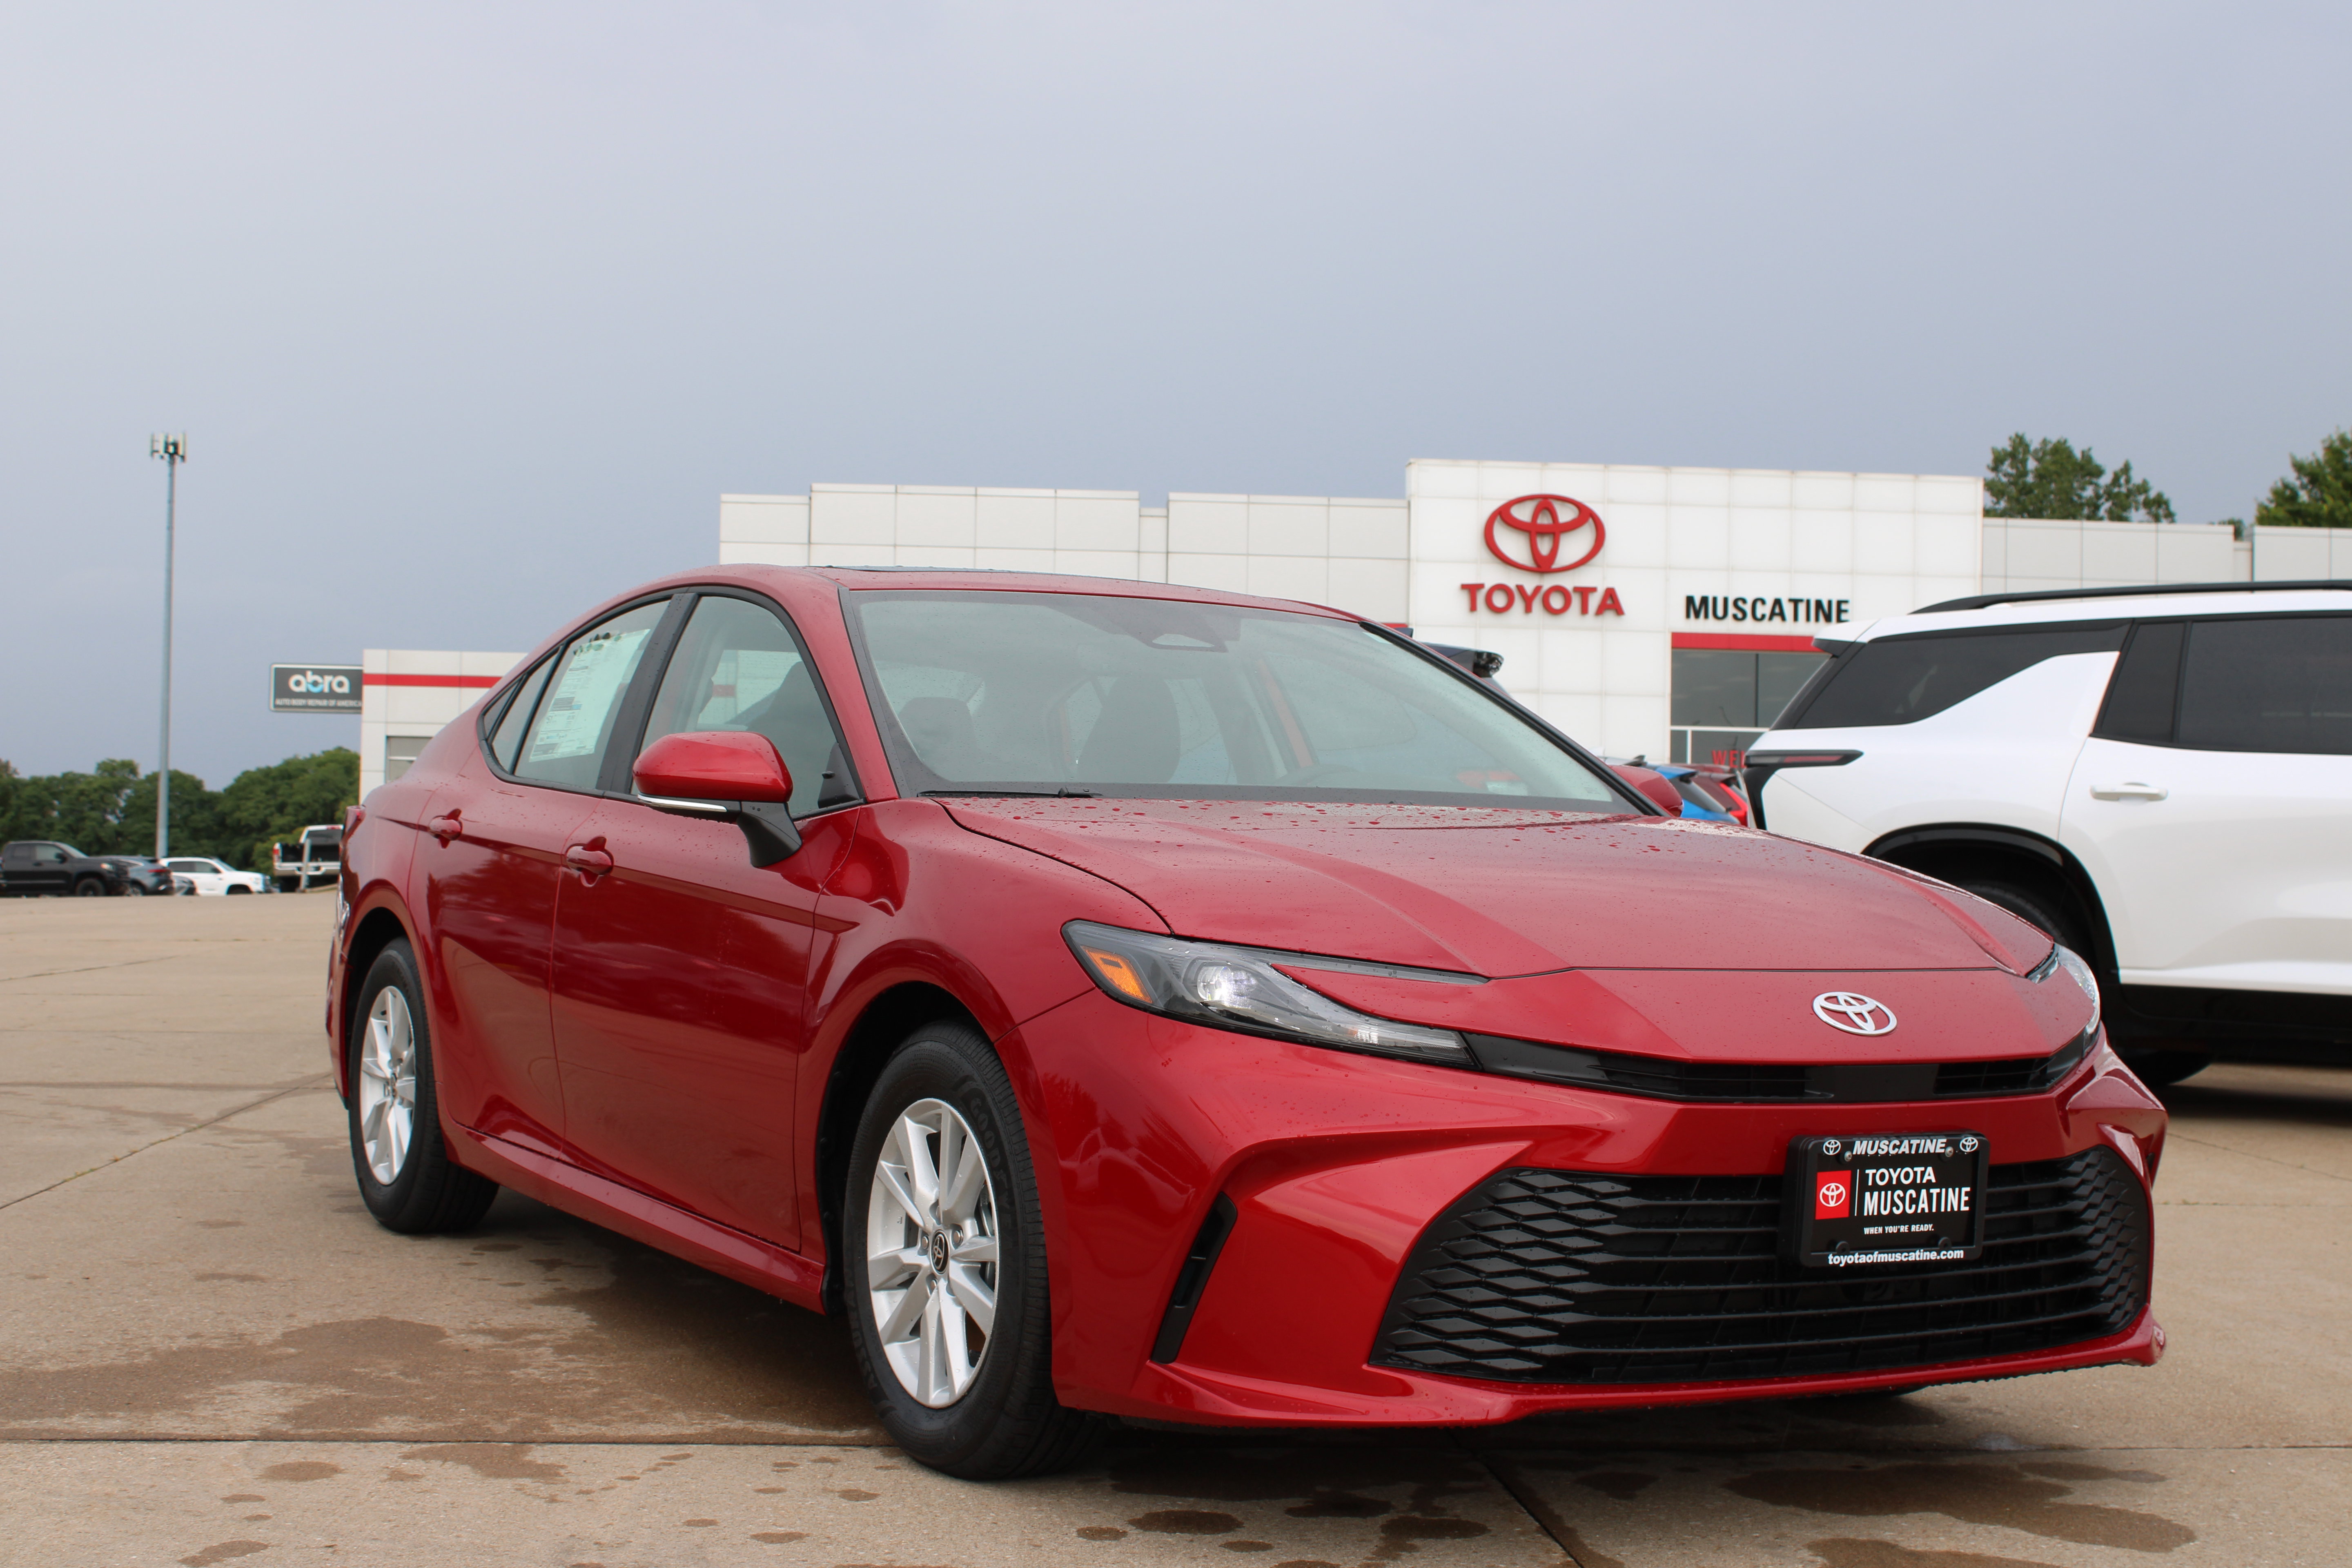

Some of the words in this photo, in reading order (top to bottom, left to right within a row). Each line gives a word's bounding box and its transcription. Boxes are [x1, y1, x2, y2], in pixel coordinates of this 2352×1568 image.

[1461, 584, 1625, 615] TOYOTA
[1686, 595, 1850, 623] MUSCATINE
[288, 670, 350, 693] abra
[1853, 1138, 1947, 1154] MUSCATINE
[1865, 1167, 1936, 1185] TOYOTA
[1864, 1187, 1971, 1216] MUSCATINE
[1864, 1226, 1883, 1235] WHEN
[1884, 1225, 1909, 1233] YOU'RE
[1911, 1224, 1934, 1232] READY.
[1828, 1250, 1964, 1266] toyotaofmuscatine.com
